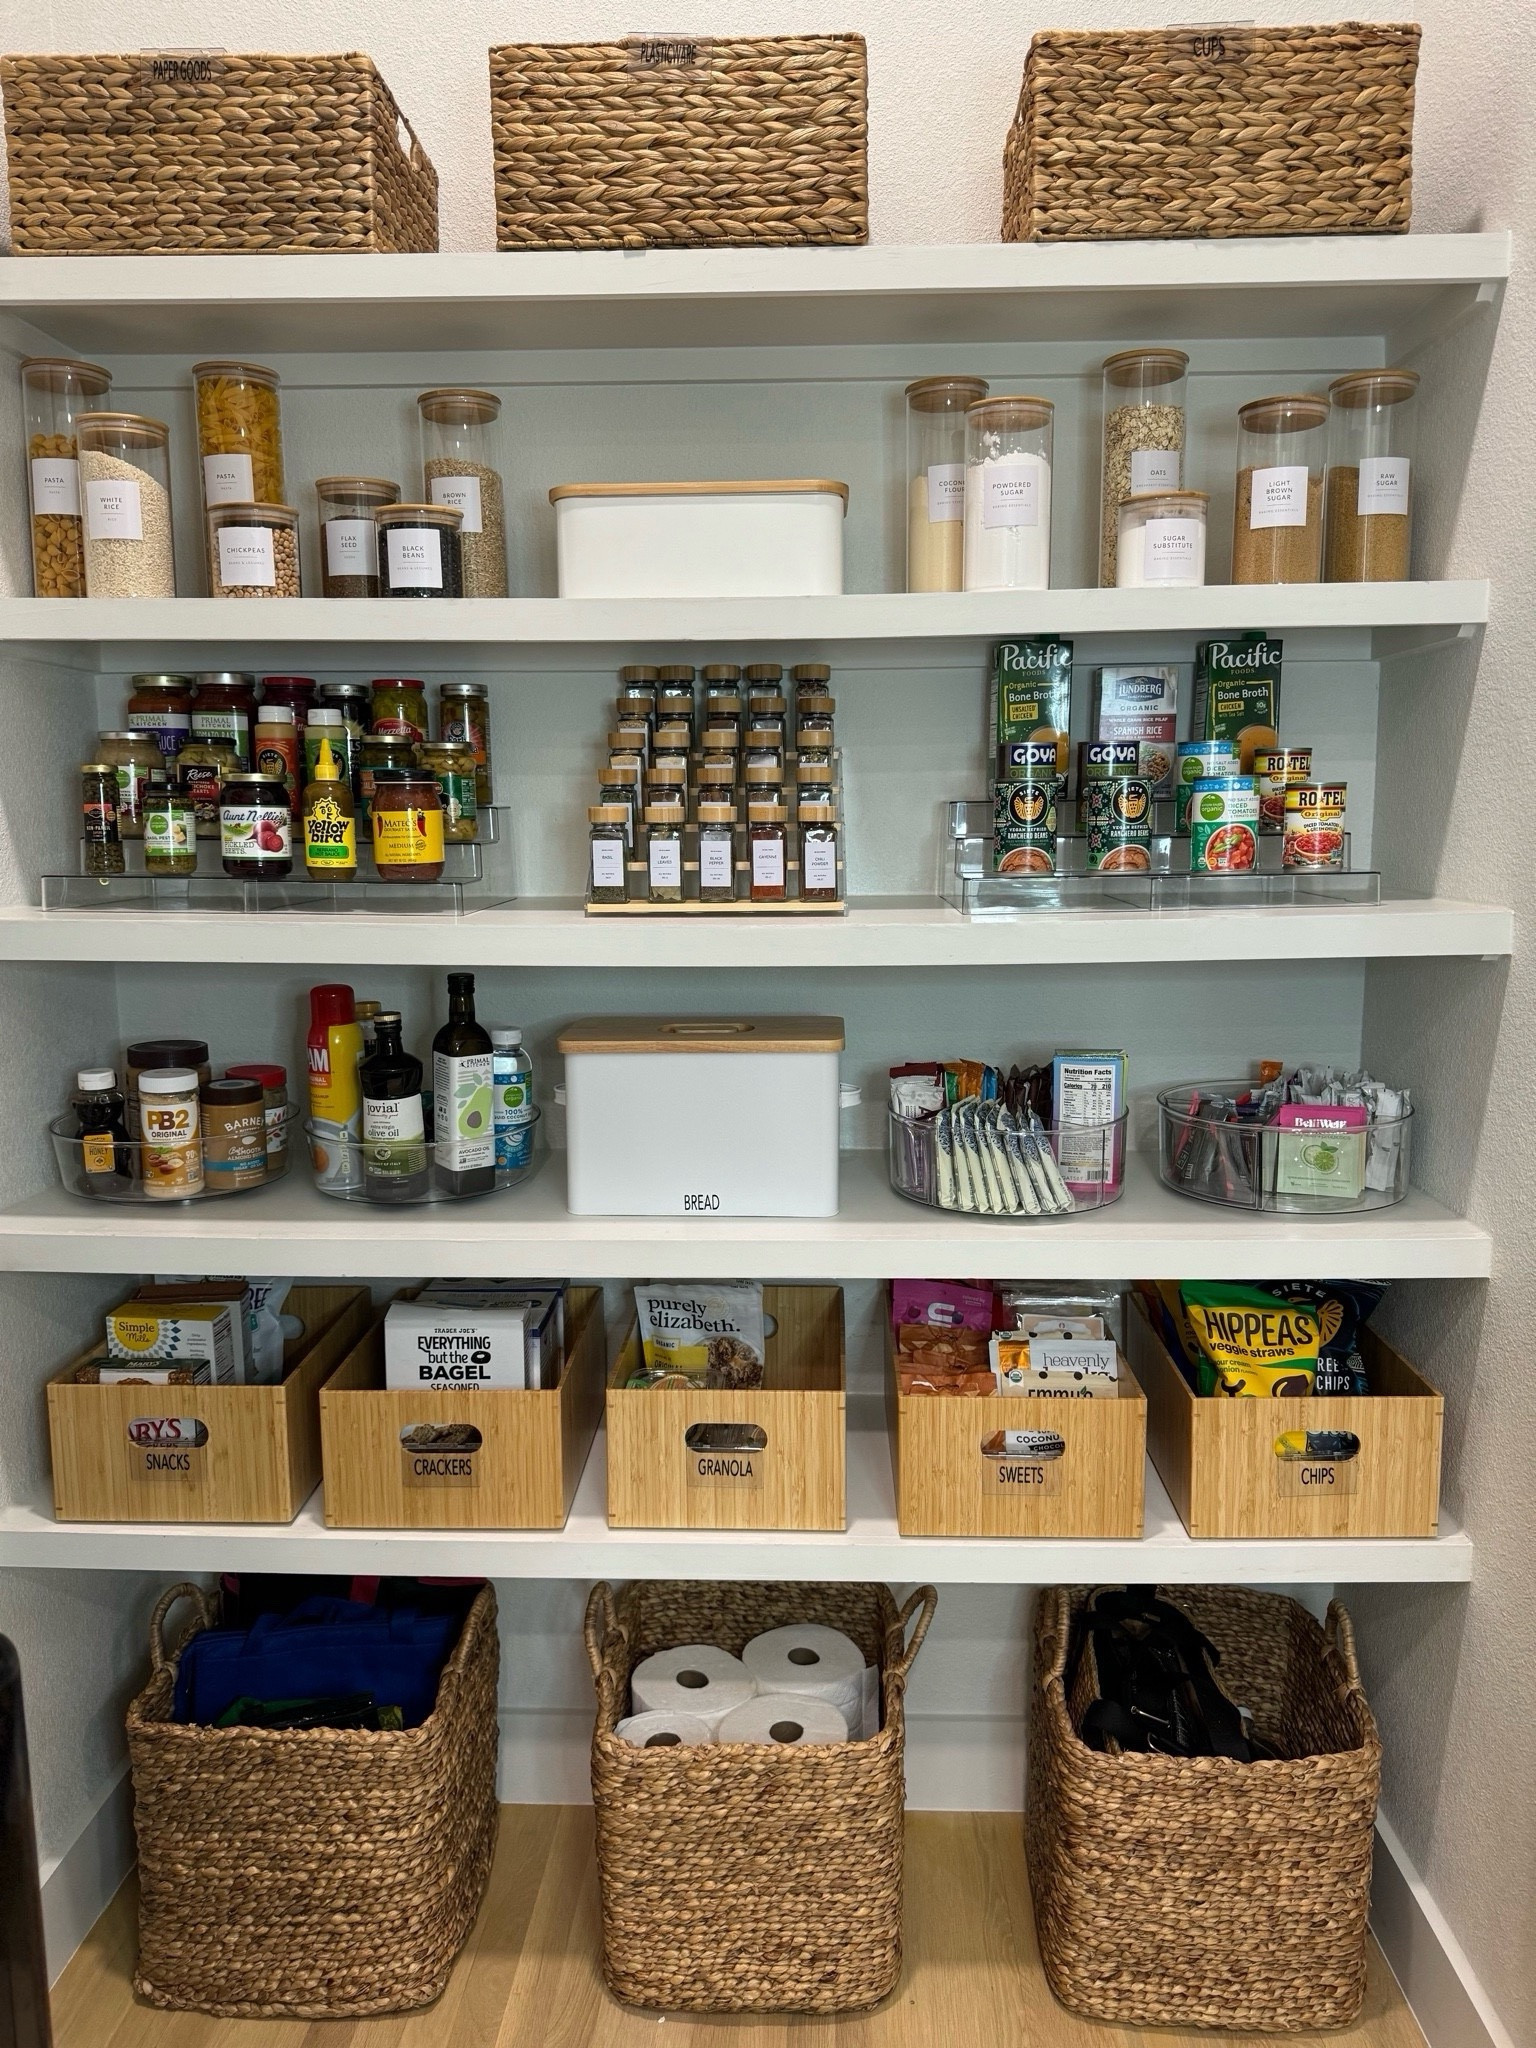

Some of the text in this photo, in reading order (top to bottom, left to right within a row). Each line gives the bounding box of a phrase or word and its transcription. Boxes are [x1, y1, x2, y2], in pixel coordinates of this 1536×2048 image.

[640, 43, 696, 64] PLASTICWARE
[1194, 36, 1225, 56] CUPS
[154, 61, 211, 80] PAPER GOODS
[1000, 644, 1073, 672] Pacific
[1209, 642, 1282, 669] Pacific
[1009, 682, 1036, 690] Organic
[1119, 684, 1161, 697] LUNDBERG
[1218, 680, 1245, 689] Organic
[1009, 693, 1031, 702] Bone
[1217, 687, 1269, 700] Bone Broth
[1012, 712, 1033, 720] CHICKEN
[1114, 726, 1162, 735] SPANISH RICE
[1014, 748, 1056, 764] GOYA
[1090, 746, 1136, 763] GOYA
[186, 768, 212, 781] Reese
[223, 810, 245, 820] Aunt
[311, 830, 343, 843] bird
[1064, 1068, 1092, 1076] Nutrition
[367, 1102, 399, 1115] jovial
[146, 1110, 190, 1130] PB2
[224, 1117, 265, 1132] BARNE
[152, 1130, 187, 1138] ORIGINAL
[368, 1129, 399, 1137] olive oil
[684, 1195, 720, 1210] BREAD
[1272, 1283, 1326, 1298] SIETE
[647, 1298, 707, 1318] purely
[119, 1321, 155, 1333] Simple
[1203, 1308, 1313, 1347] HIPPEAS
[126, 1333, 151, 1343] Mills
[418, 1336, 491, 1350] EVERYTHING
[429, 1351, 468, 1364] but the
[1209, 1342, 1295, 1358] veggie straws
[1043, 1352, 1110, 1369] heavenly
[1214, 1359, 1228, 1367] our
[419, 1365, 491, 1380] BAGEL
[1317, 1375, 1350, 1391] CHIPS
[1016, 1435, 1062, 1443] COCONU
[146, 1453, 190, 1471] SNACKS
[414, 1459, 472, 1476] CRACKERS
[698, 1459, 753, 1477] GRANOLA
[999, 1466, 1044, 1484] SWEETS
[1301, 1468, 1335, 1484] CHIPS
